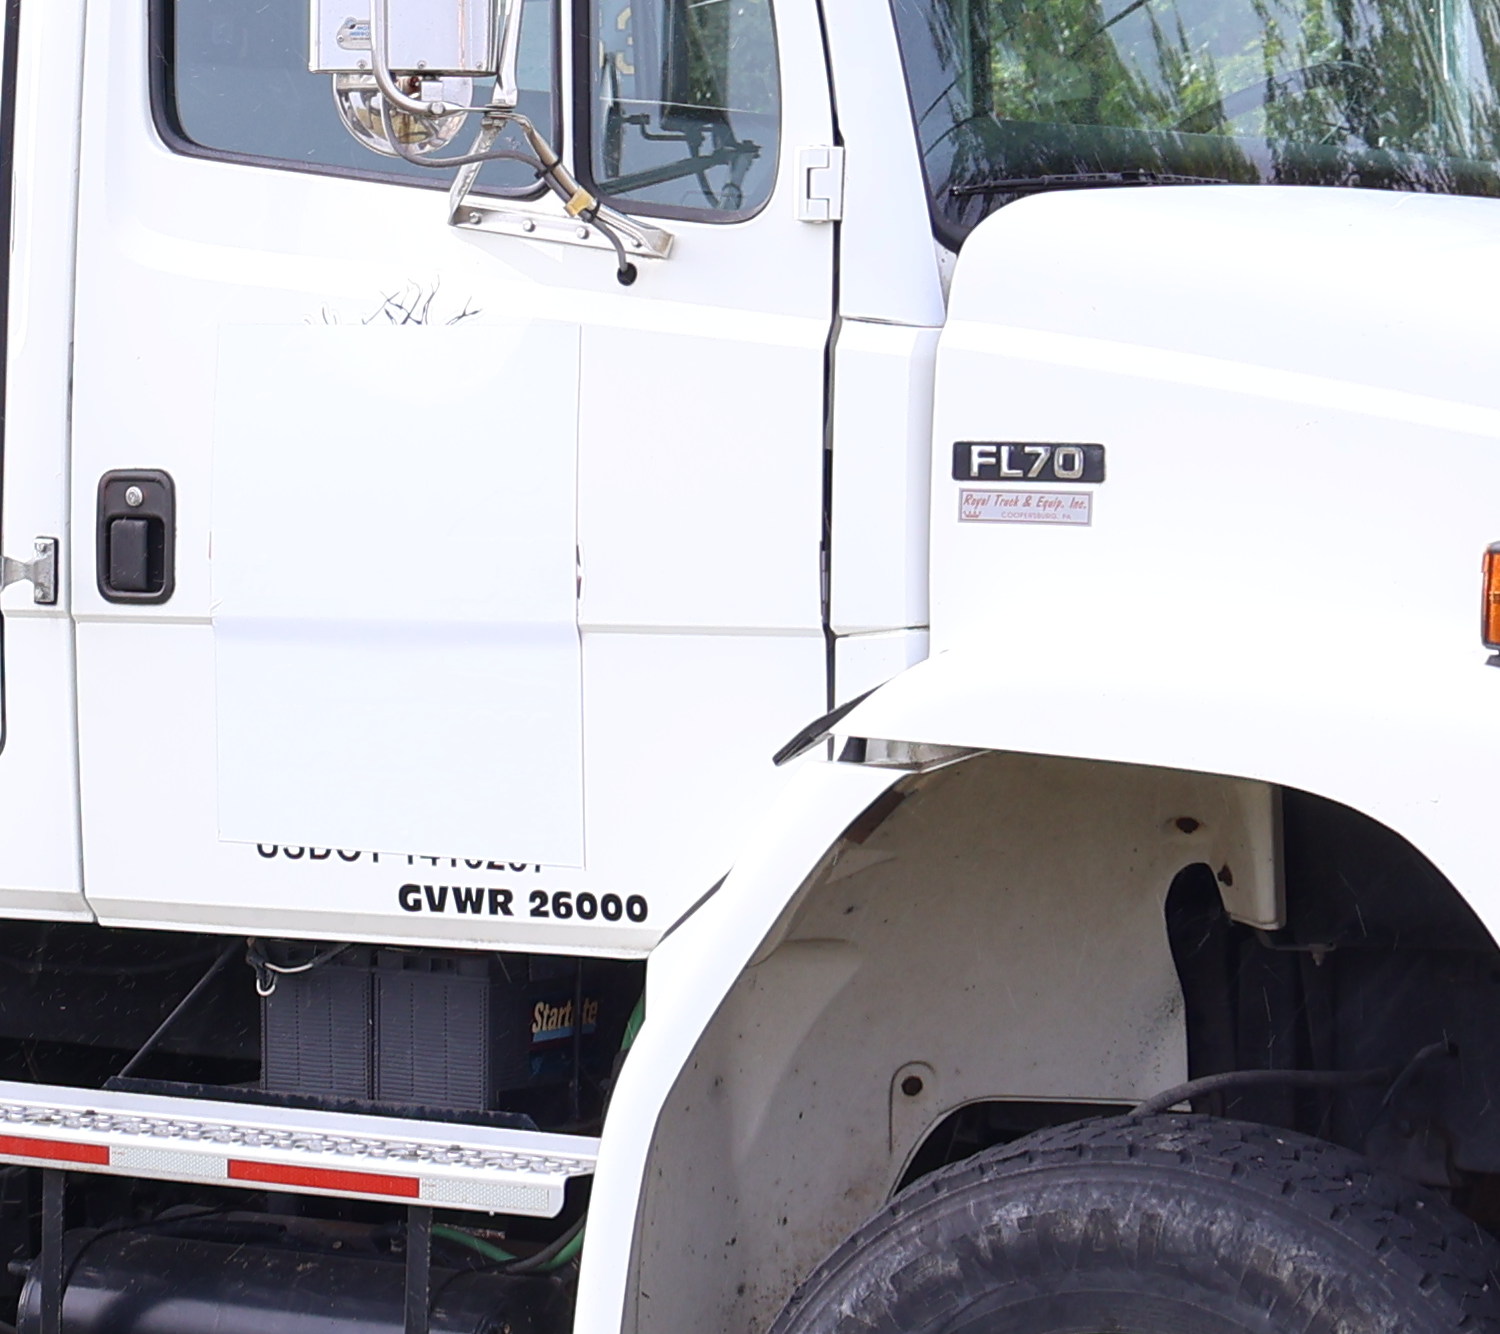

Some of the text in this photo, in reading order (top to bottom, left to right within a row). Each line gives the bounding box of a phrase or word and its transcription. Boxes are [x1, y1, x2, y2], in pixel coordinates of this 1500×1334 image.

[969, 444, 1085, 479] FL70
[963, 494, 1087, 510] Royal Truck & Equip. Inc.
[397, 882, 649, 923] GVWR 26000
[531, 997, 598, 1034] Startte
